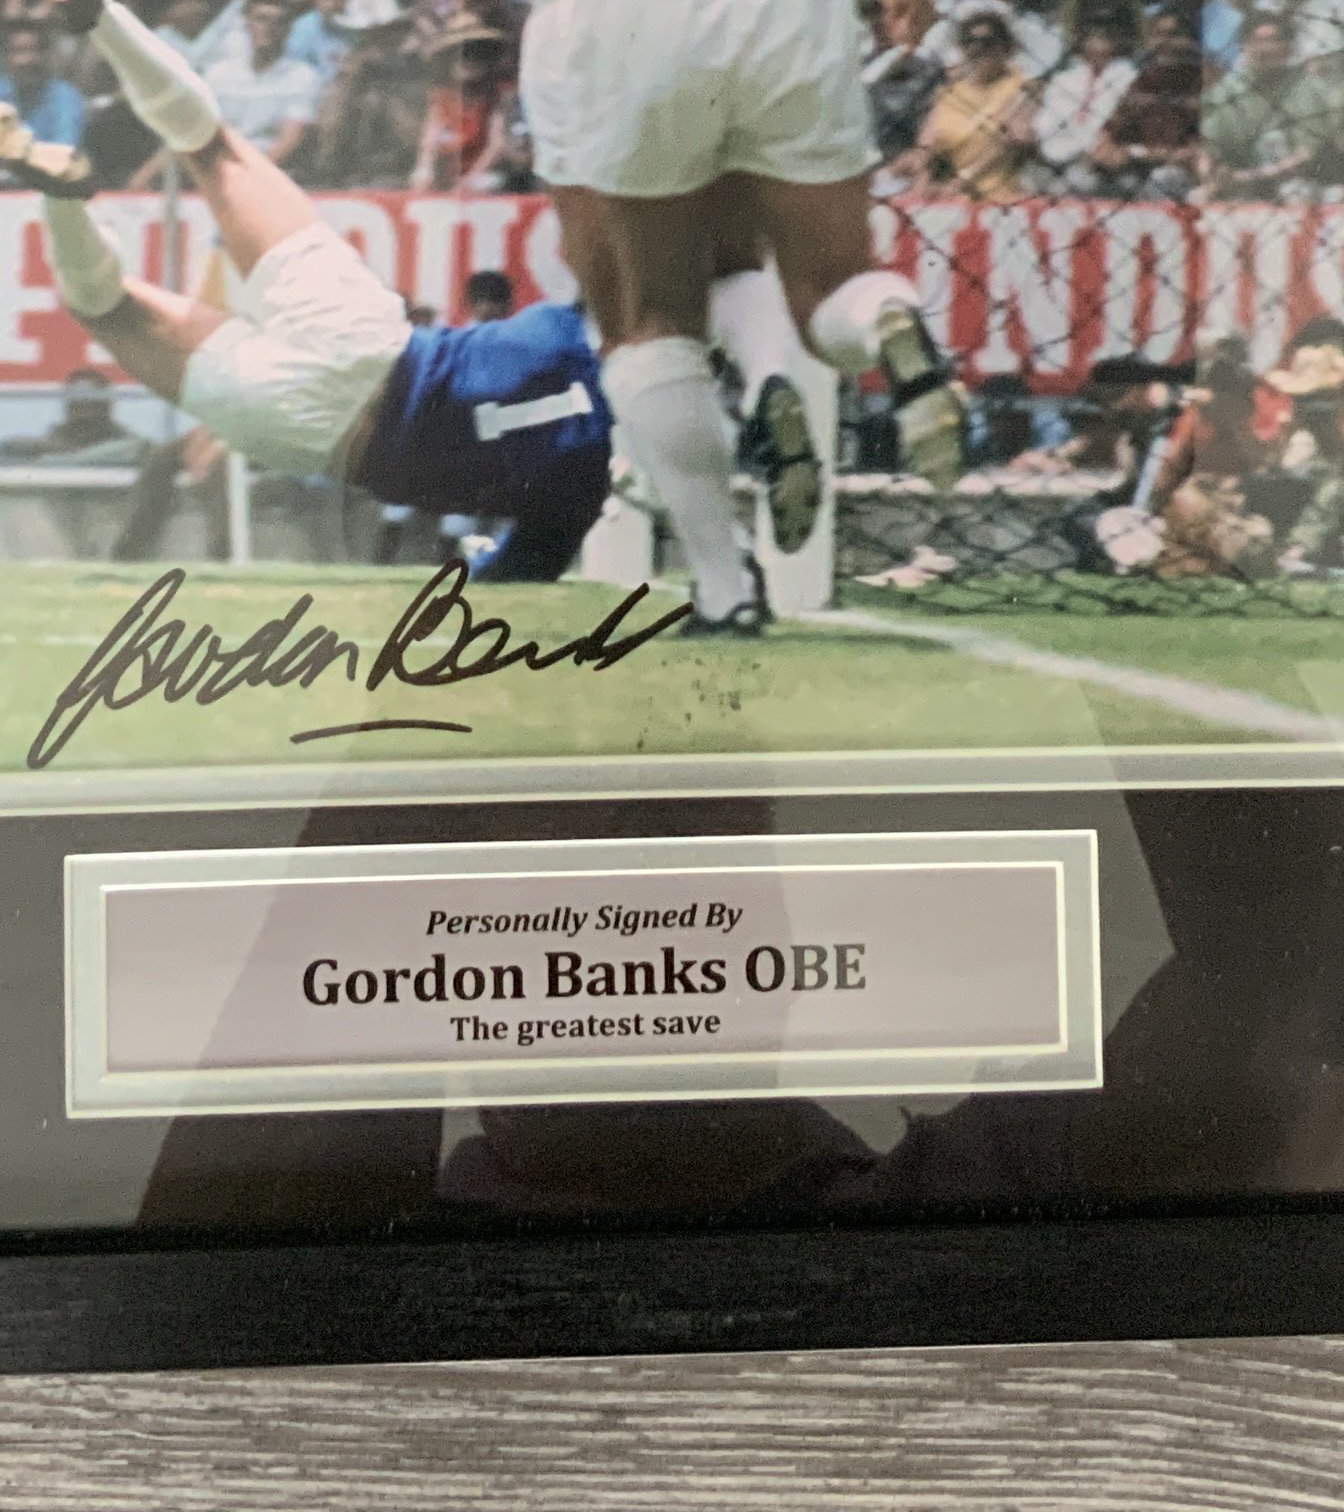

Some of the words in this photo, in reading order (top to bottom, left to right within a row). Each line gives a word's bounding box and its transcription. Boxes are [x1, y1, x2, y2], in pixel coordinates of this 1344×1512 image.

[473, 381, 594, 442] 1
[425, 906, 589, 939] Personally
[594, 903, 699, 937] Signed
[704, 902, 744, 935] By
[302, 952, 527, 1007] Gordon
[544, 945, 728, 999] Banks
[744, 943, 867, 994] OBE
[449, 1015, 509, 1042] The
[517, 1013, 646, 1047] greatest
[652, 1014, 722, 1036] save
